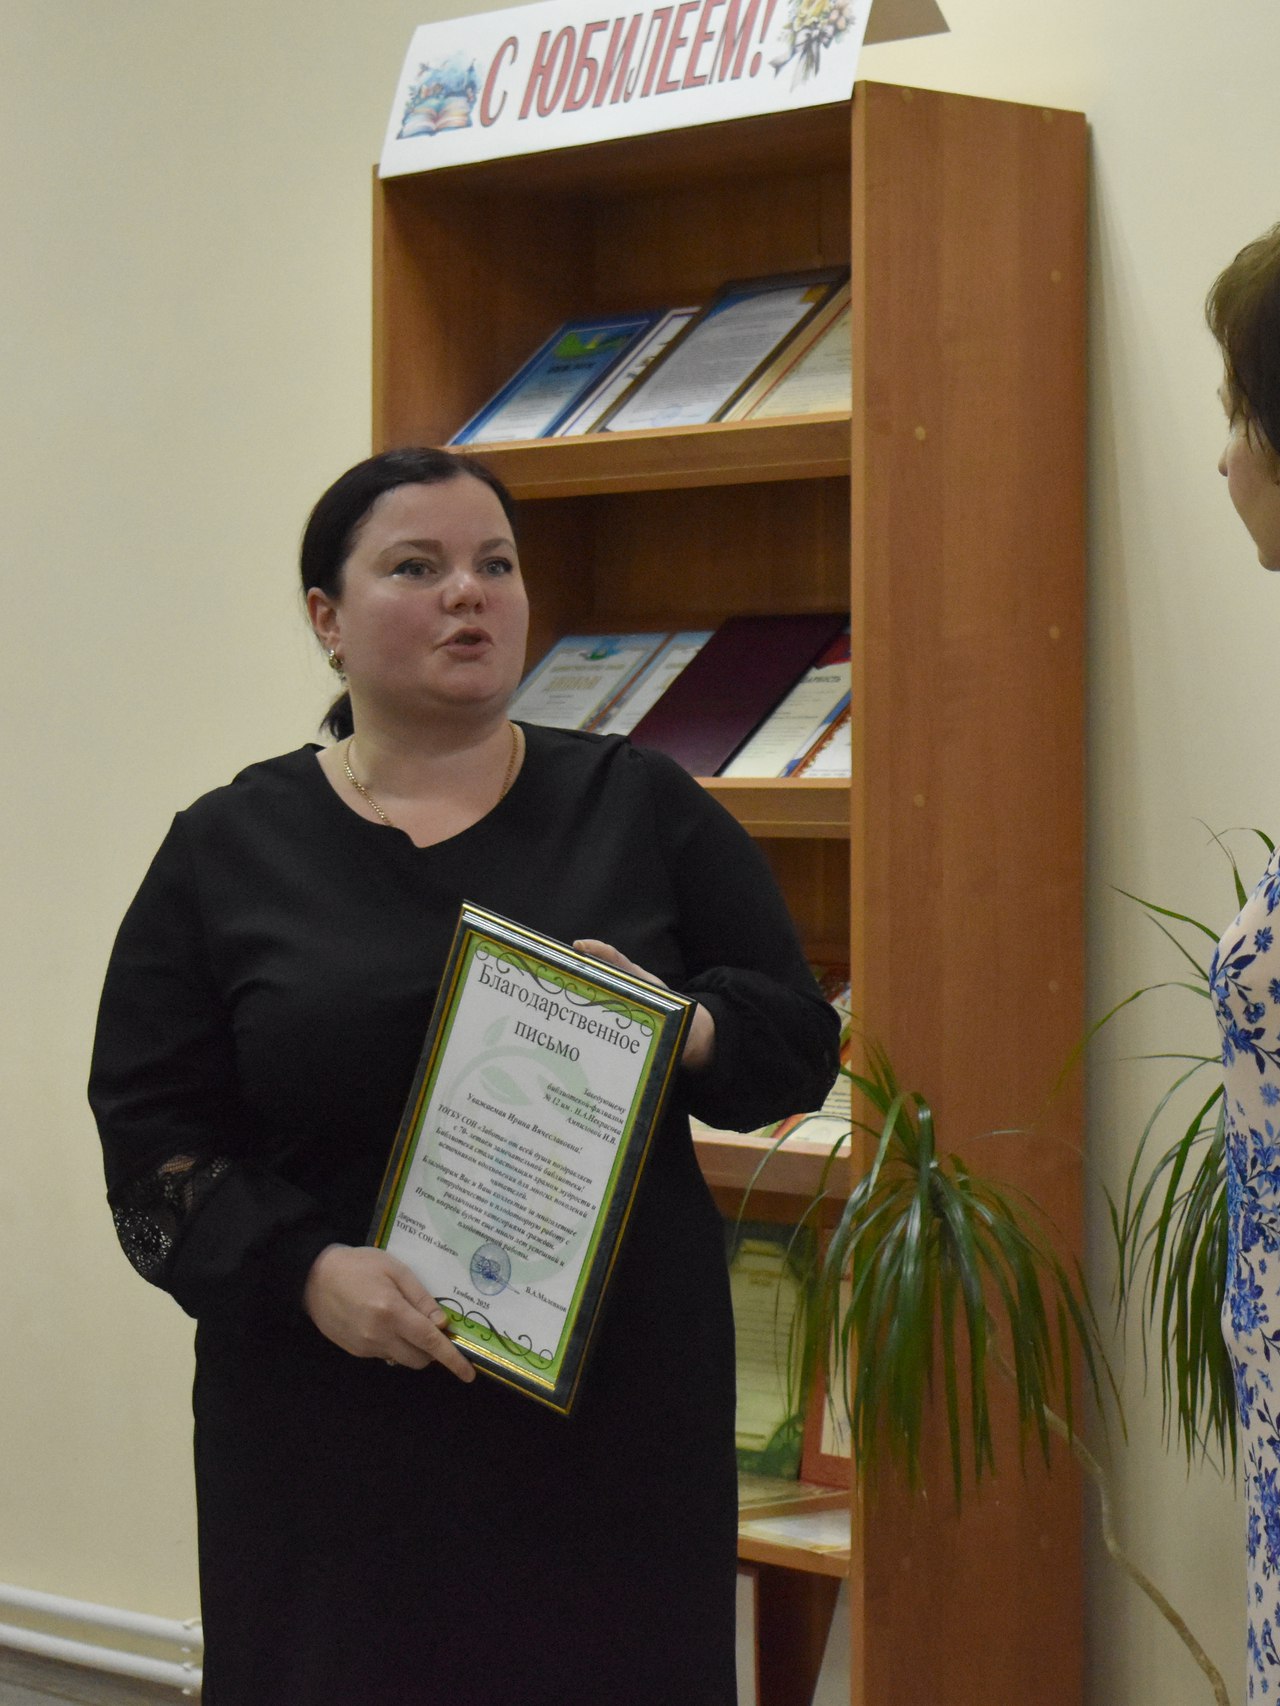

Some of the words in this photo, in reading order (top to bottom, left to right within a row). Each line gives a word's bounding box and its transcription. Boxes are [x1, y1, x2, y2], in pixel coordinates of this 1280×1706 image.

[480, 36, 519, 127] С
[518, 0, 778, 120] ЮБИЛЕЕМ!
[478, 963, 639, 1054] Благодарственное
[513, 1020, 580, 1062] письмо
[437, 1103, 460, 1120] ТОГБУ
[460, 1115, 478, 1129] СОН
[466, 1091, 507, 1118] Уважаемая
[506, 1112, 531, 1130] Ирина
[551, 1095, 561, 1106] 12
[417, 1230, 433, 1245] СОН
